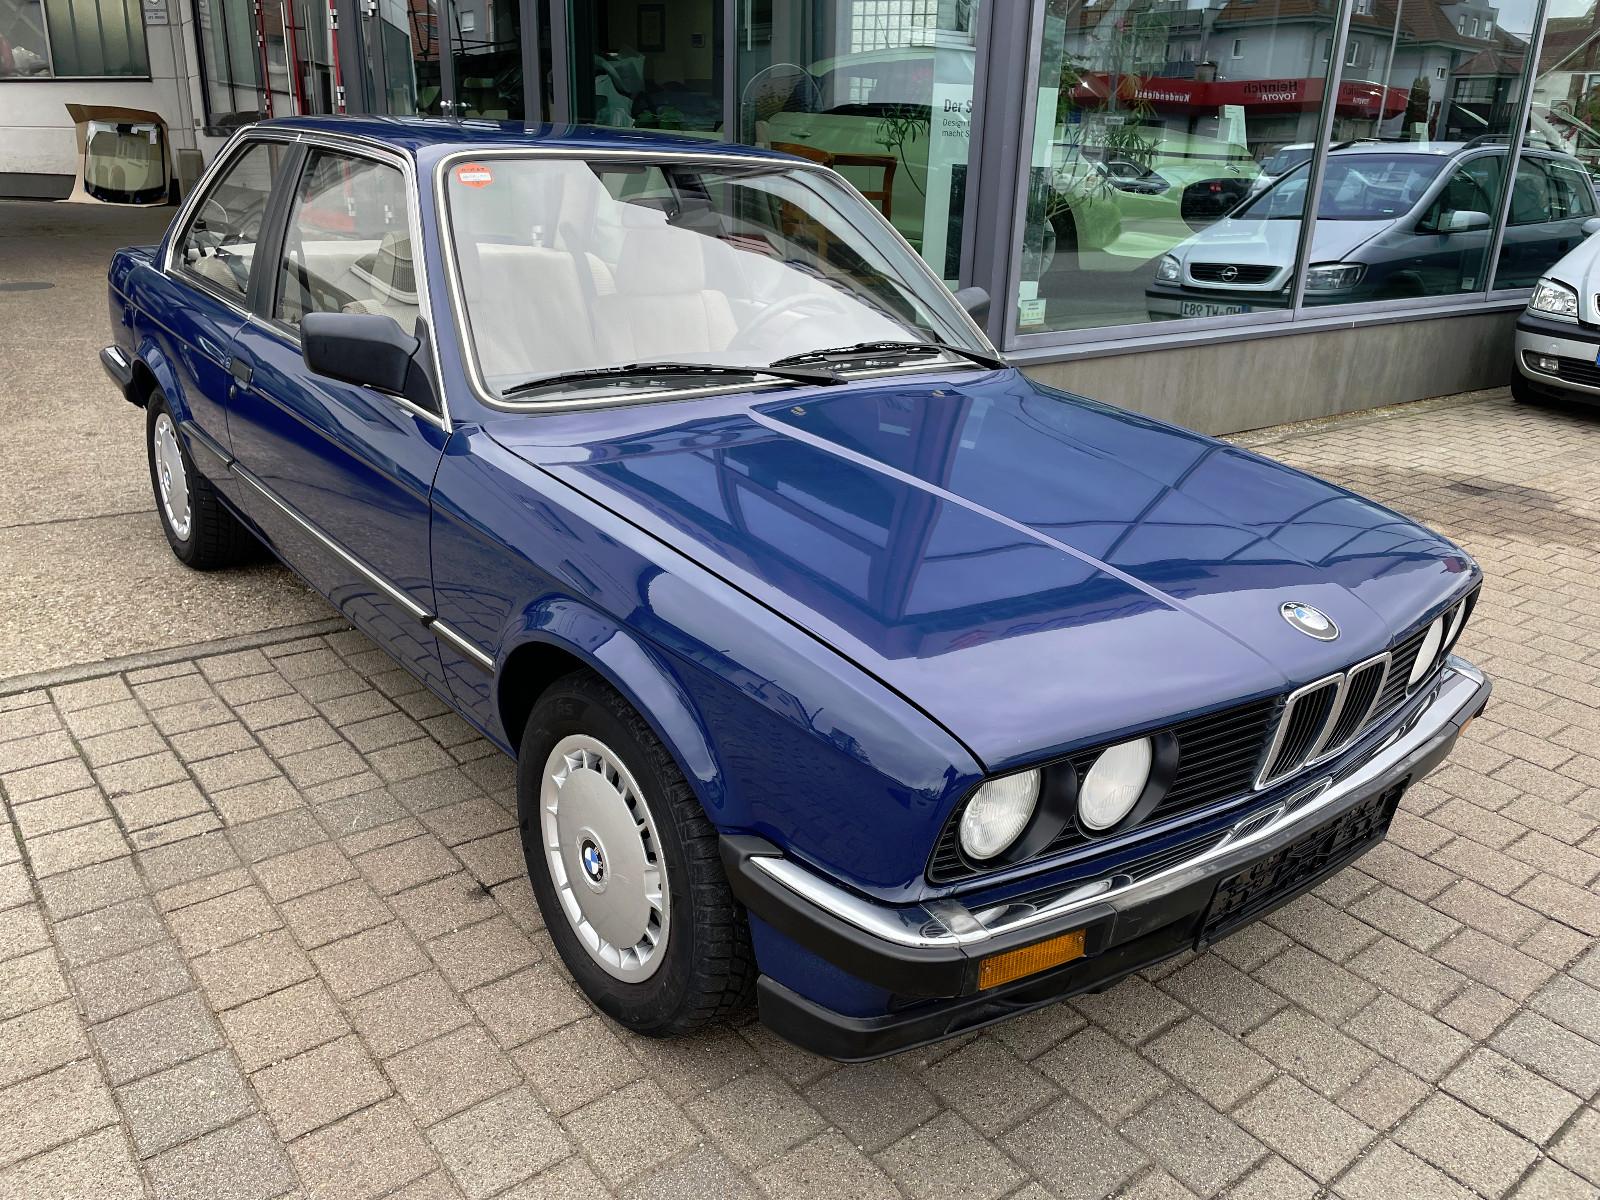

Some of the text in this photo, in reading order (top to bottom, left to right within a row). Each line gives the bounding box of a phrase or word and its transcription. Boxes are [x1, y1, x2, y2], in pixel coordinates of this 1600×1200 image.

[943, 98, 962, 113] Der
[942, 118, 965, 129] Design
[941, 130, 963, 138] macht
